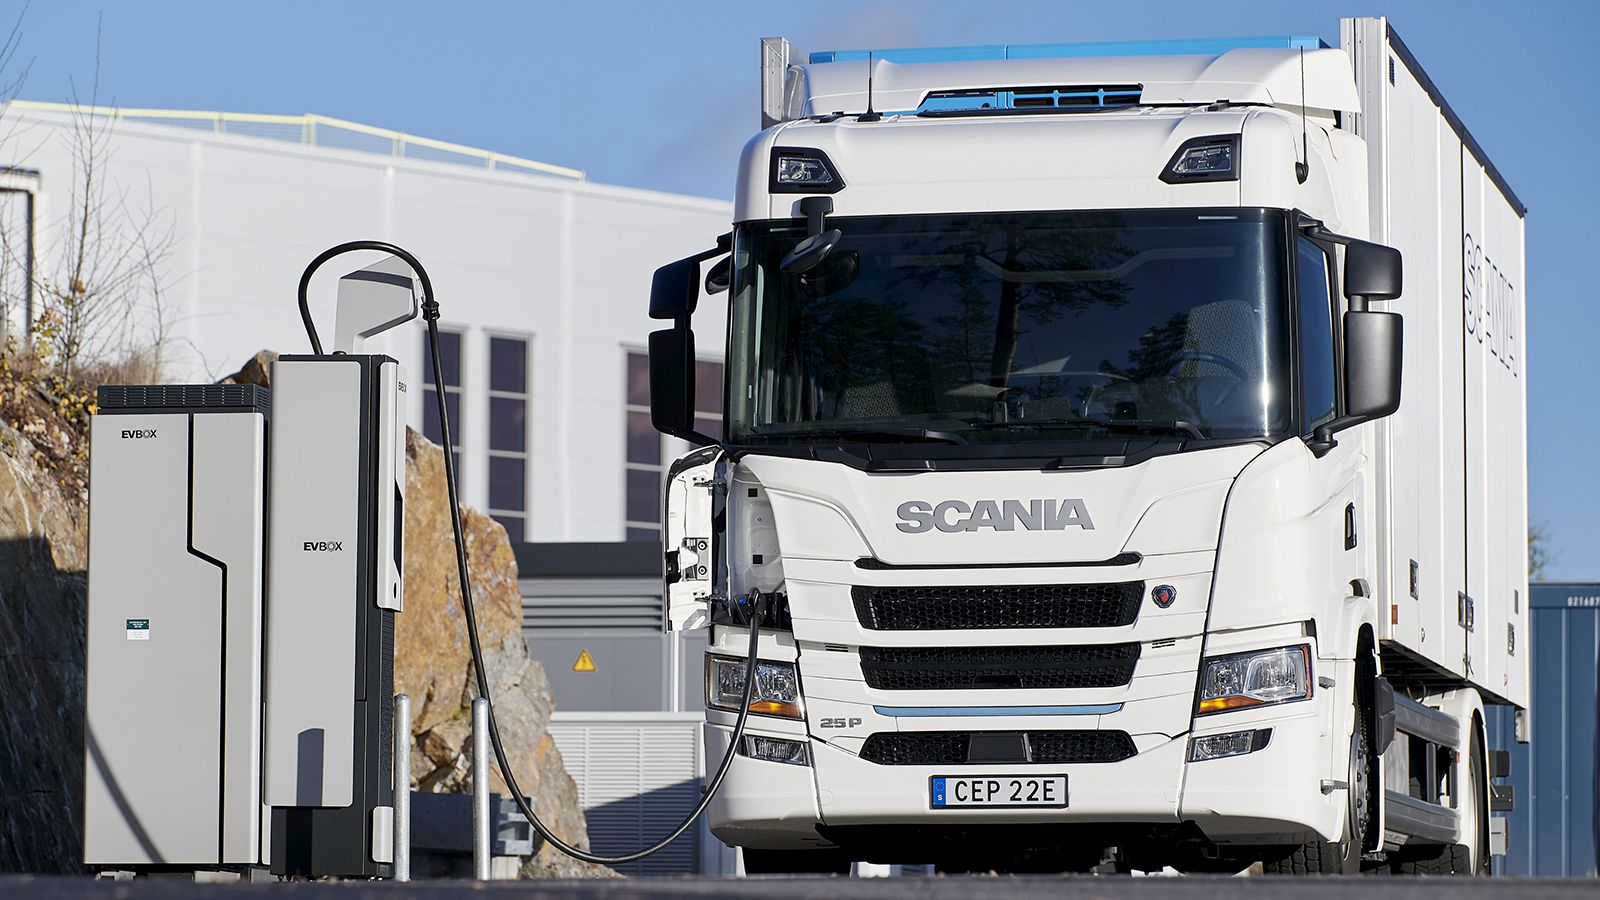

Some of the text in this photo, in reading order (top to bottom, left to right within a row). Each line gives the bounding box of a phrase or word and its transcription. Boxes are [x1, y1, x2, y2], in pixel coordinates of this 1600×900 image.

[1464, 232, 1518, 378] SCANIA
[121, 429, 157, 439] EVBOX
[895, 498, 1096, 534] SCANIA
[303, 540, 343, 552] EVBOX
[955, 780, 1056, 802] CEP 22E
